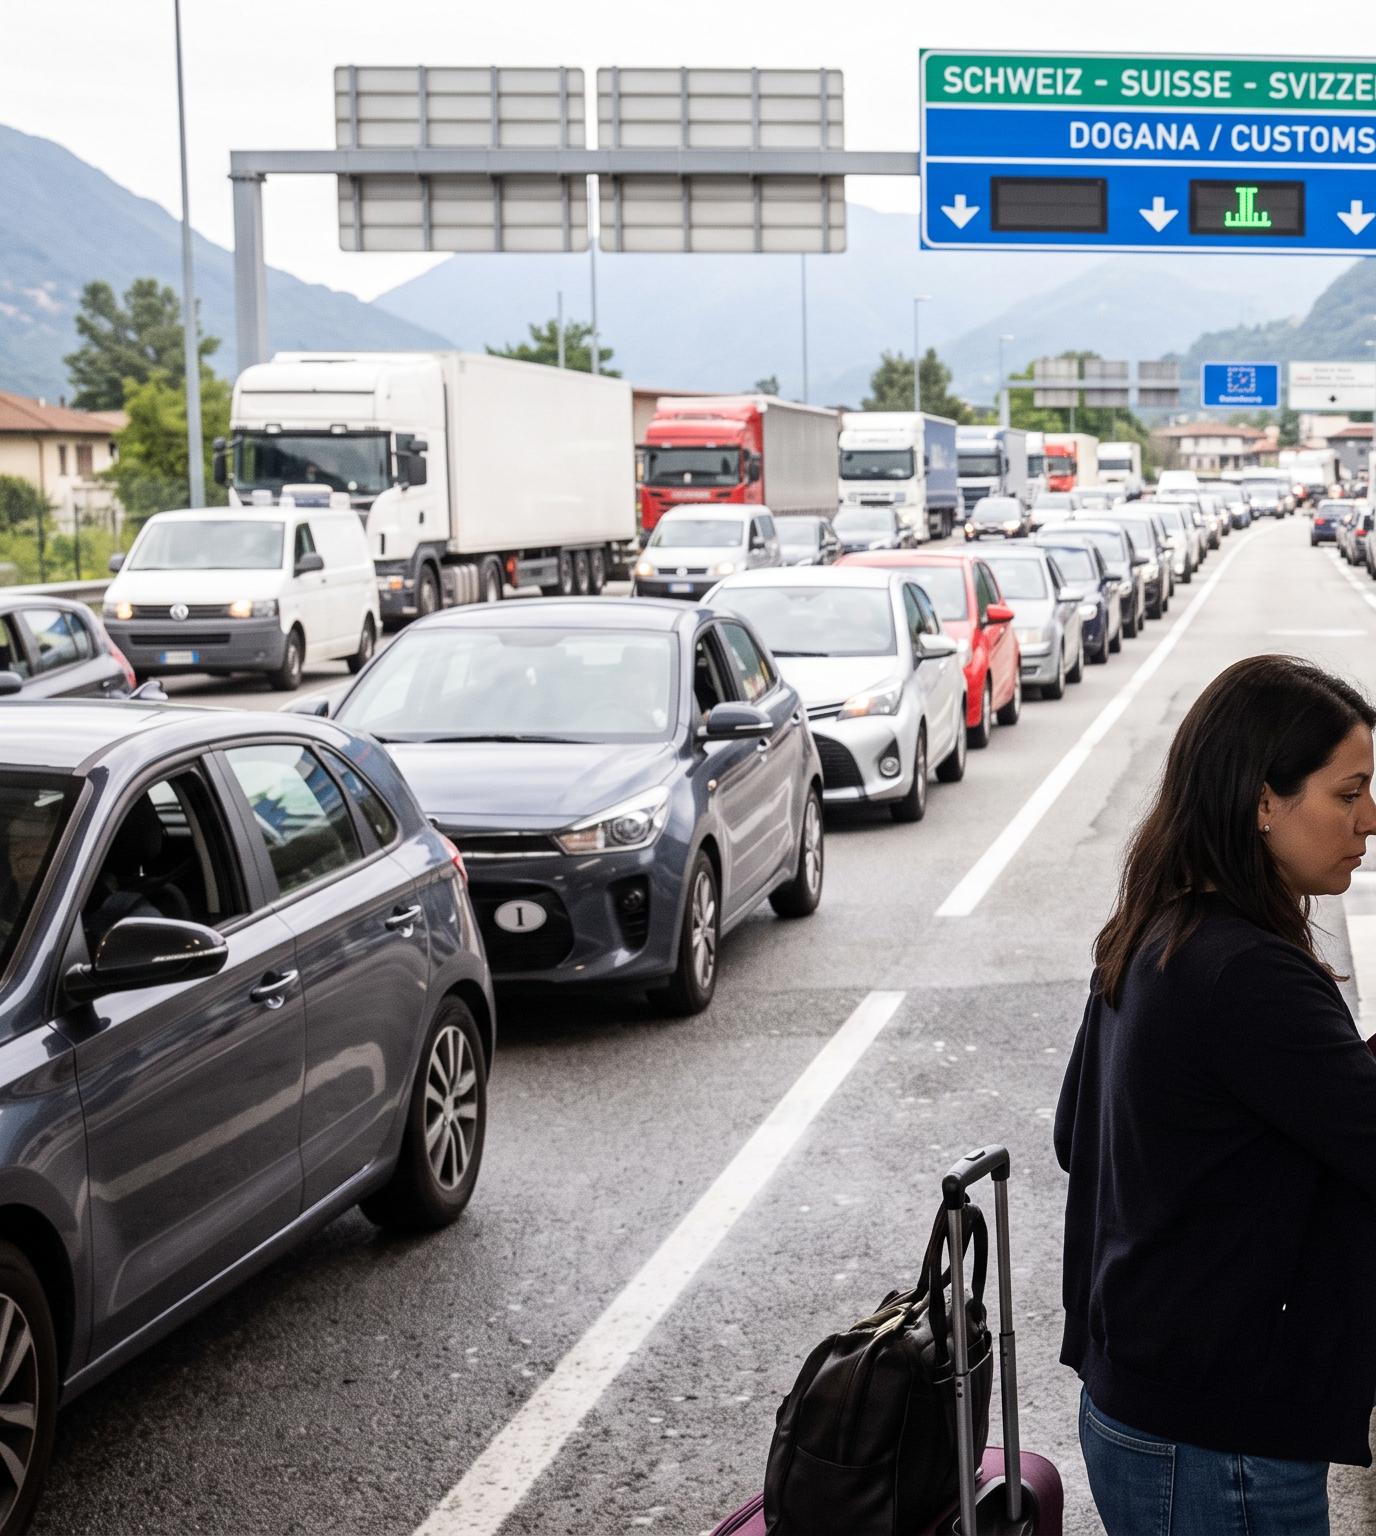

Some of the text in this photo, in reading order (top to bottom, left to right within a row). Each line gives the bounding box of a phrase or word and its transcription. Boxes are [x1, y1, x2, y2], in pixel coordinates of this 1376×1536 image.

[944, 66, 1082, 95] SCHWEIZ
[1121, 70, 1231, 98] SUISSE
[1071, 122, 1376, 153] DOGANA / CUSTOMS
[516, 907, 525, 927] I
